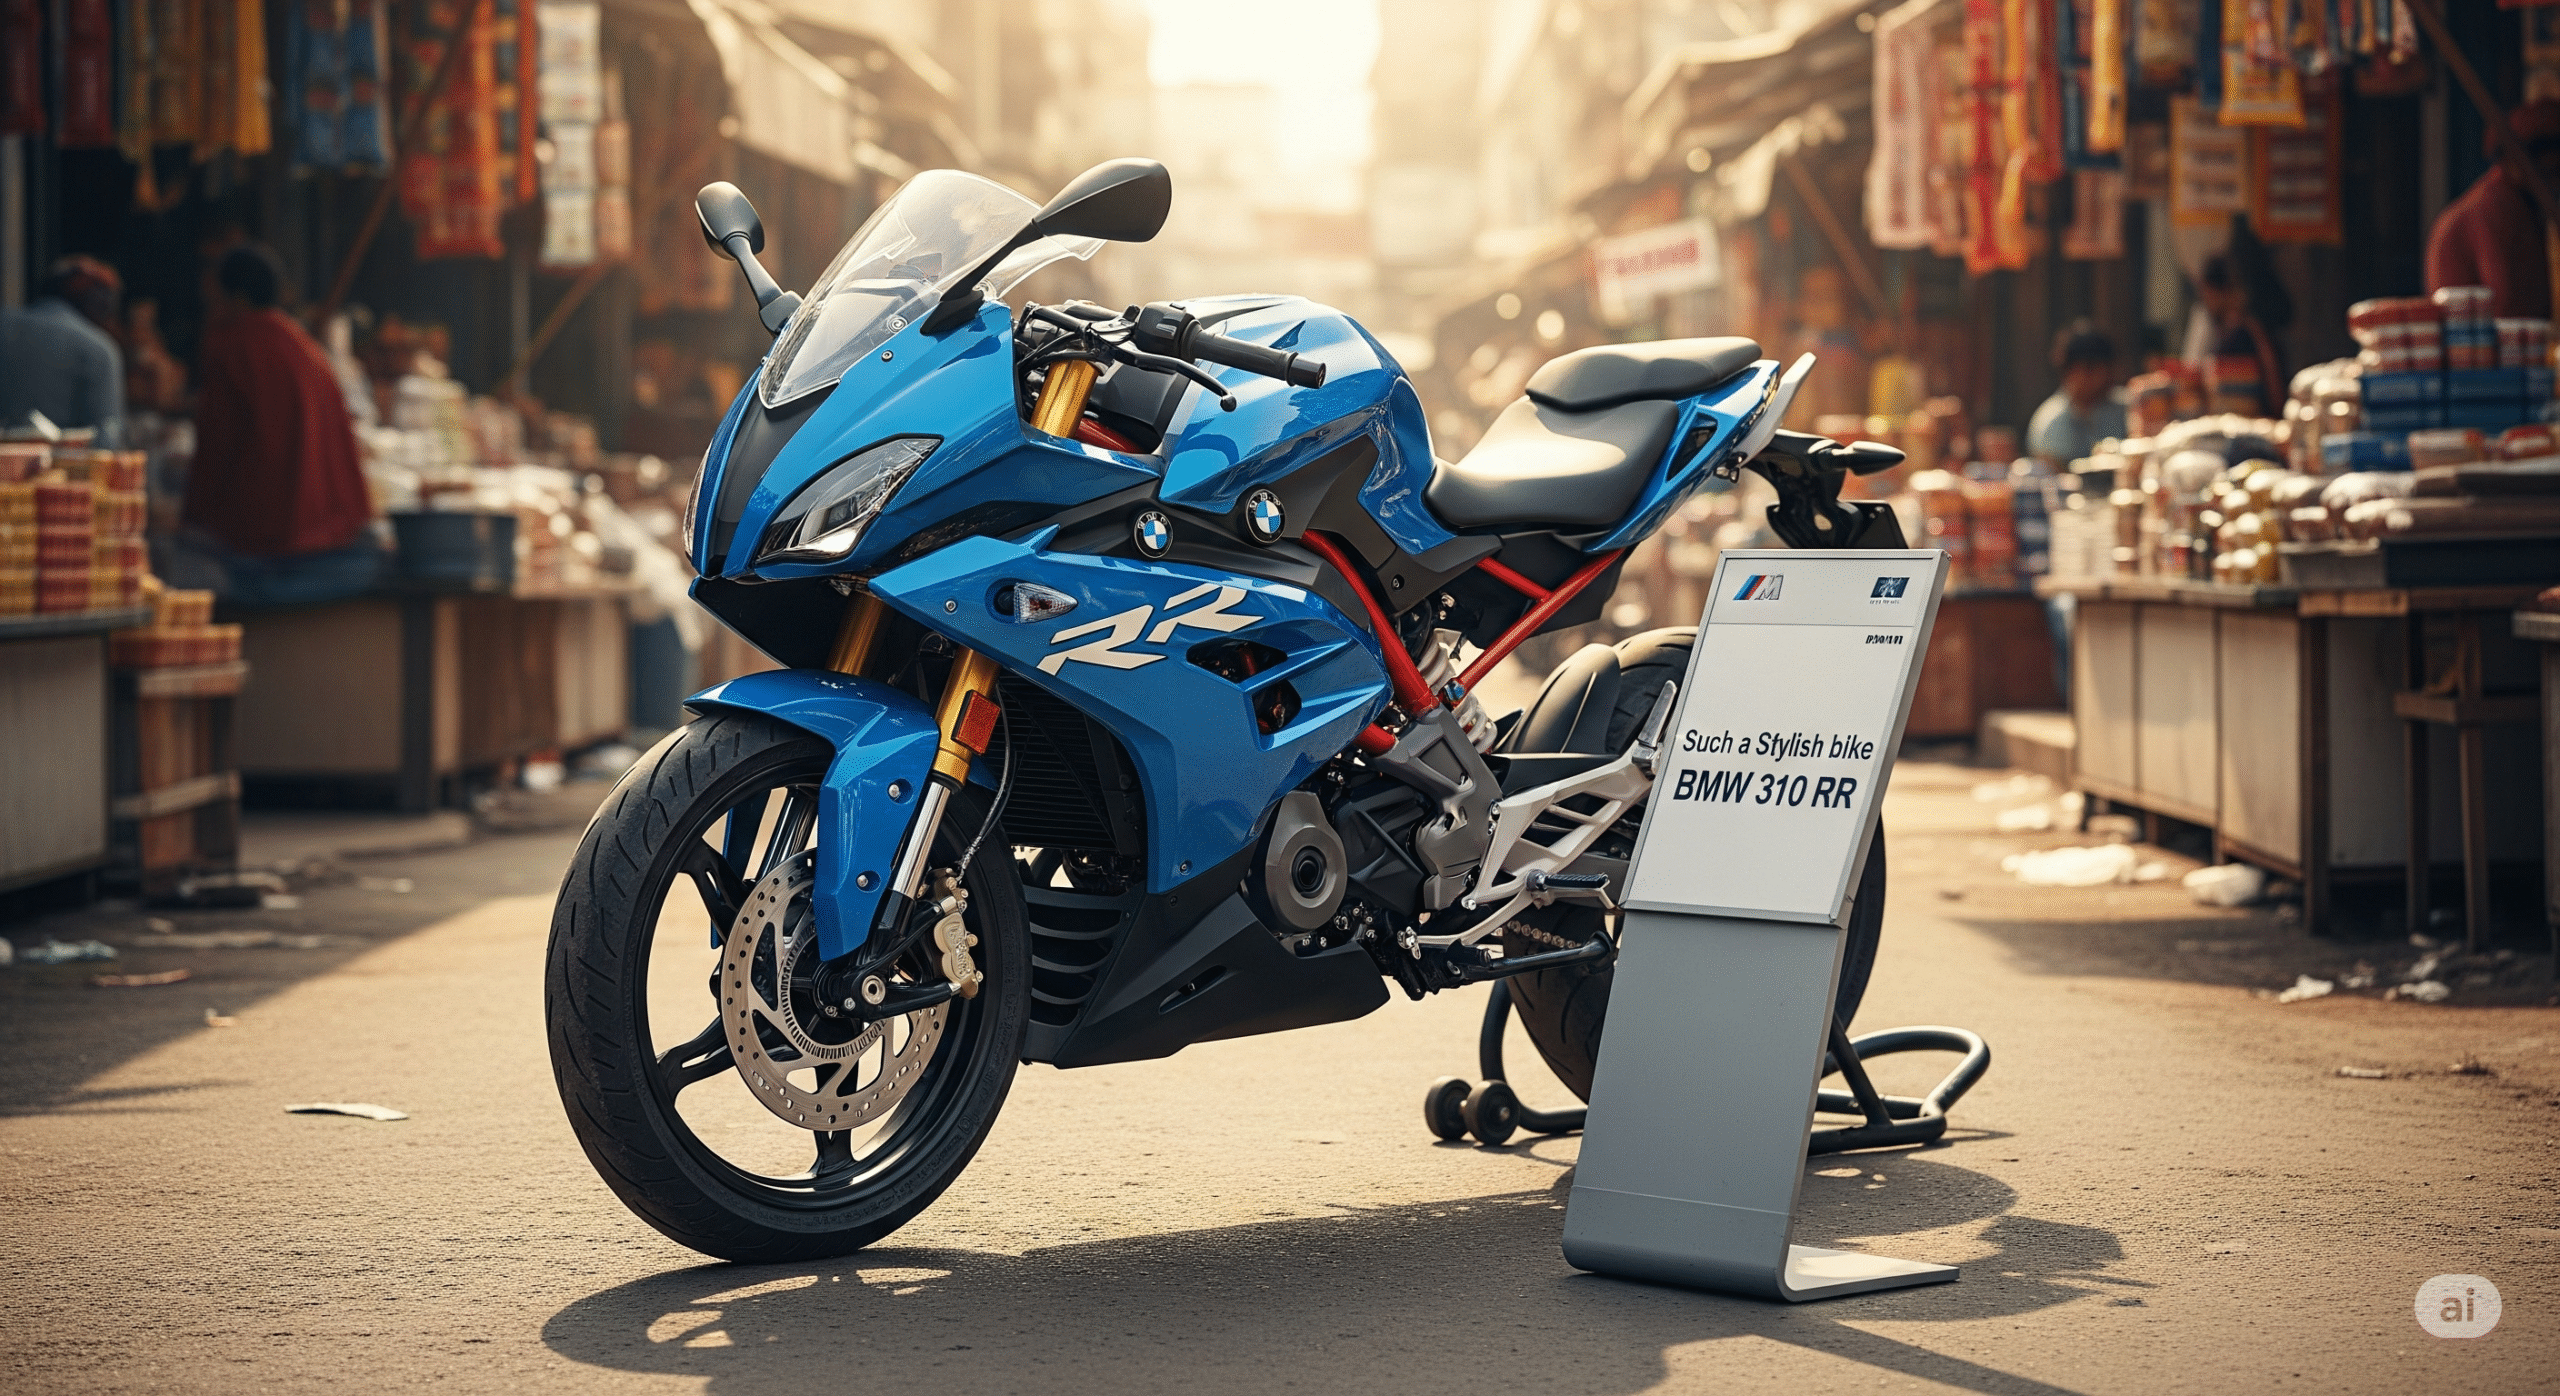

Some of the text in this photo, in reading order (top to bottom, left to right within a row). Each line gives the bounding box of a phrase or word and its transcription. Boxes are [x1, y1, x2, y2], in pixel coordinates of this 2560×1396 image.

[1036, 583, 1265, 676] RR
[1682, 728, 1875, 763] Such a Stylish bike
[1672, 768, 1858, 809] BMW 310 RR
